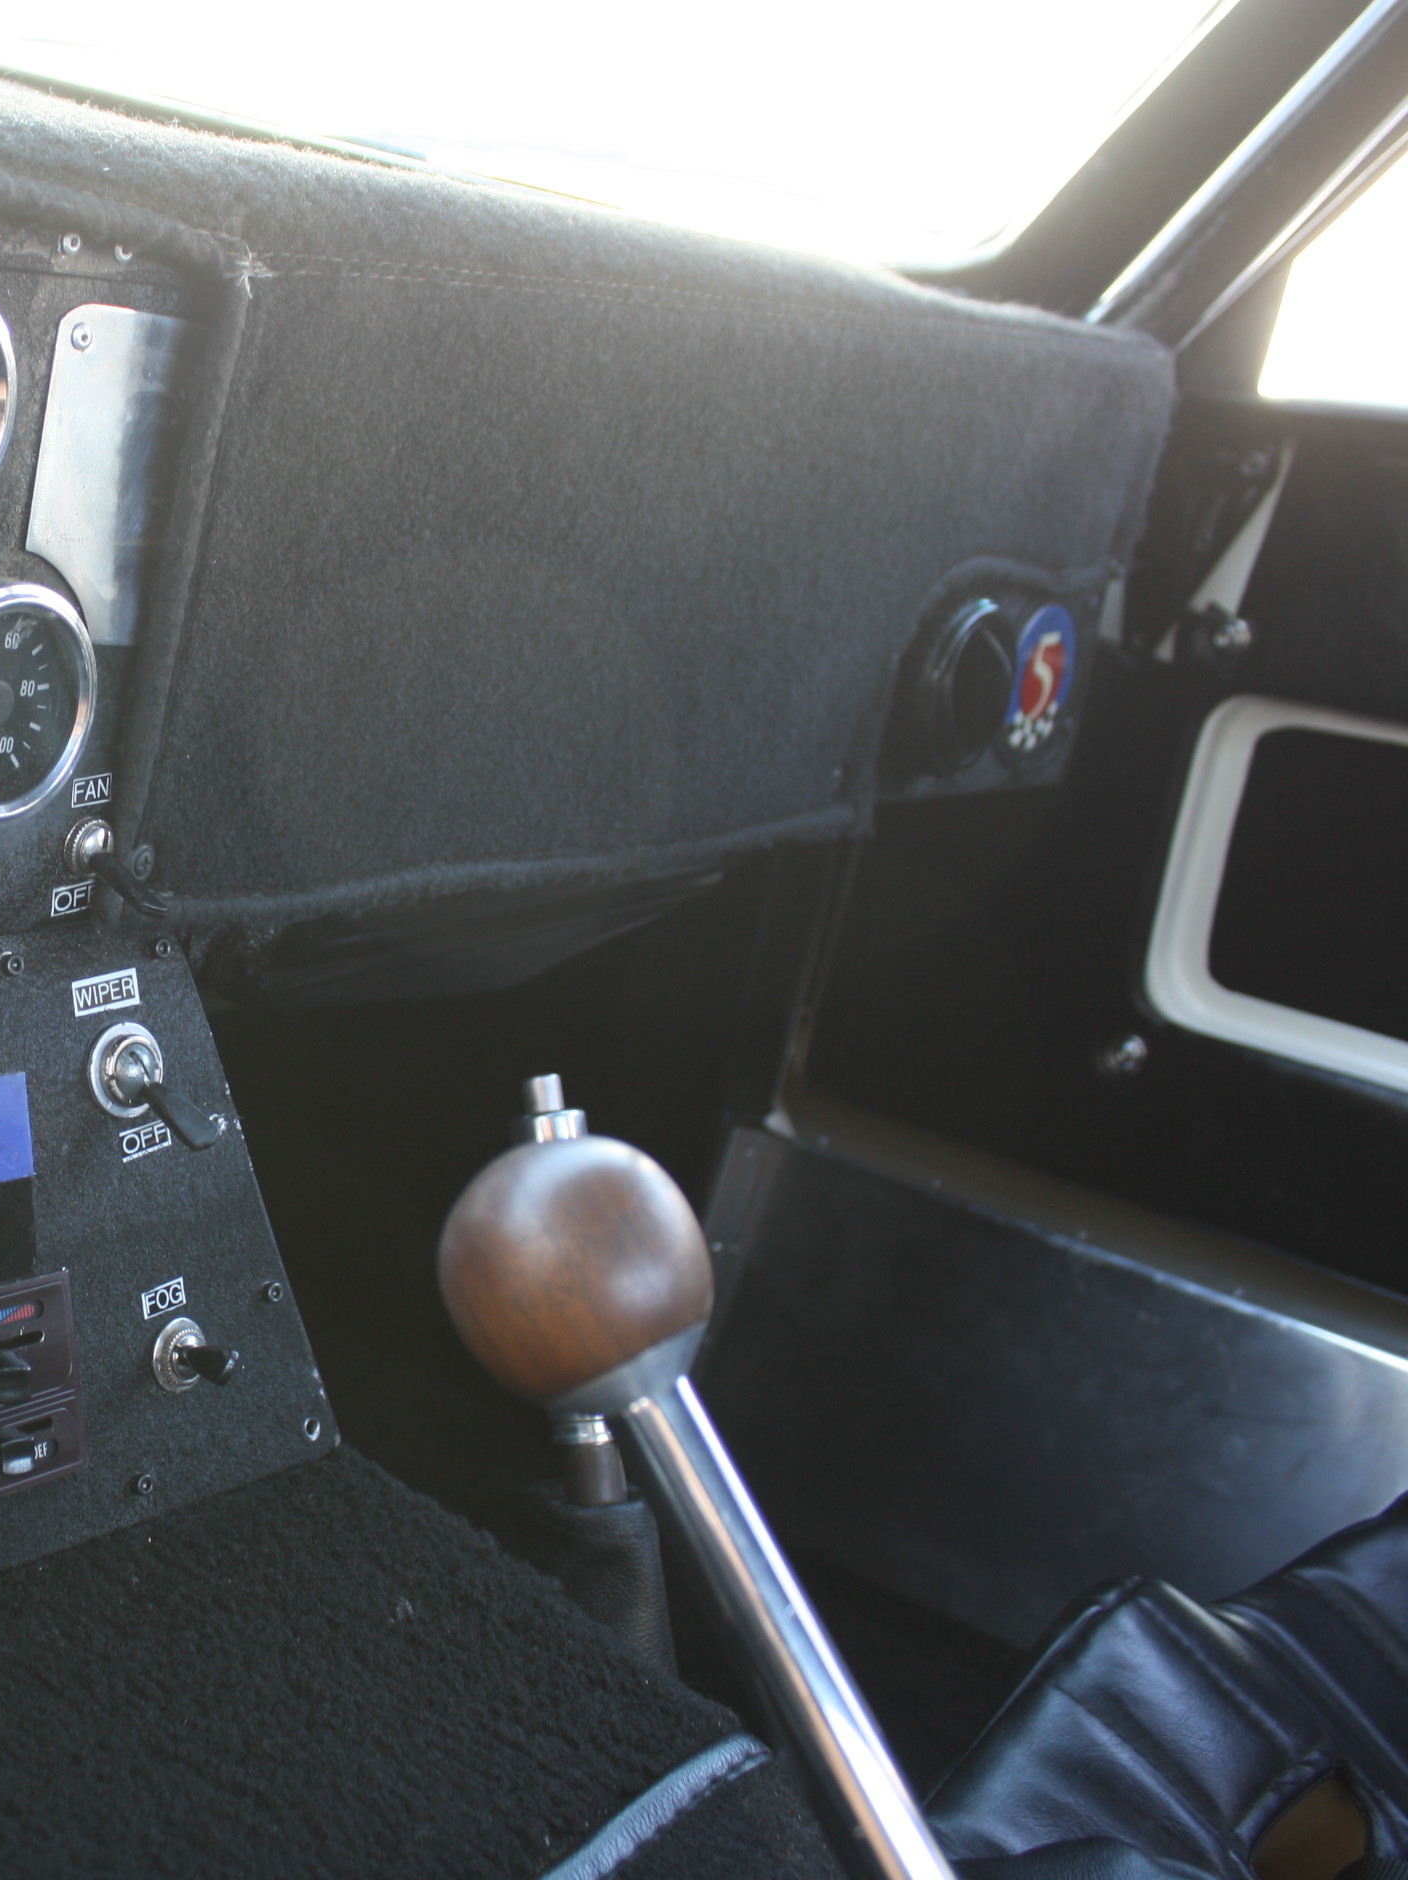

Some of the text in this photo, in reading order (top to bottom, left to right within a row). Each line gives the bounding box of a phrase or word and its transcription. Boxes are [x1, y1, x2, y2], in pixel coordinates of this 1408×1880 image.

[20, 681, 35, 697] 80
[74, 776, 109, 803] FAN
[75, 977, 135, 1009] WIPER
[122, 1121, 167, 1155] OFF
[144, 1285, 183, 1314] FOG
